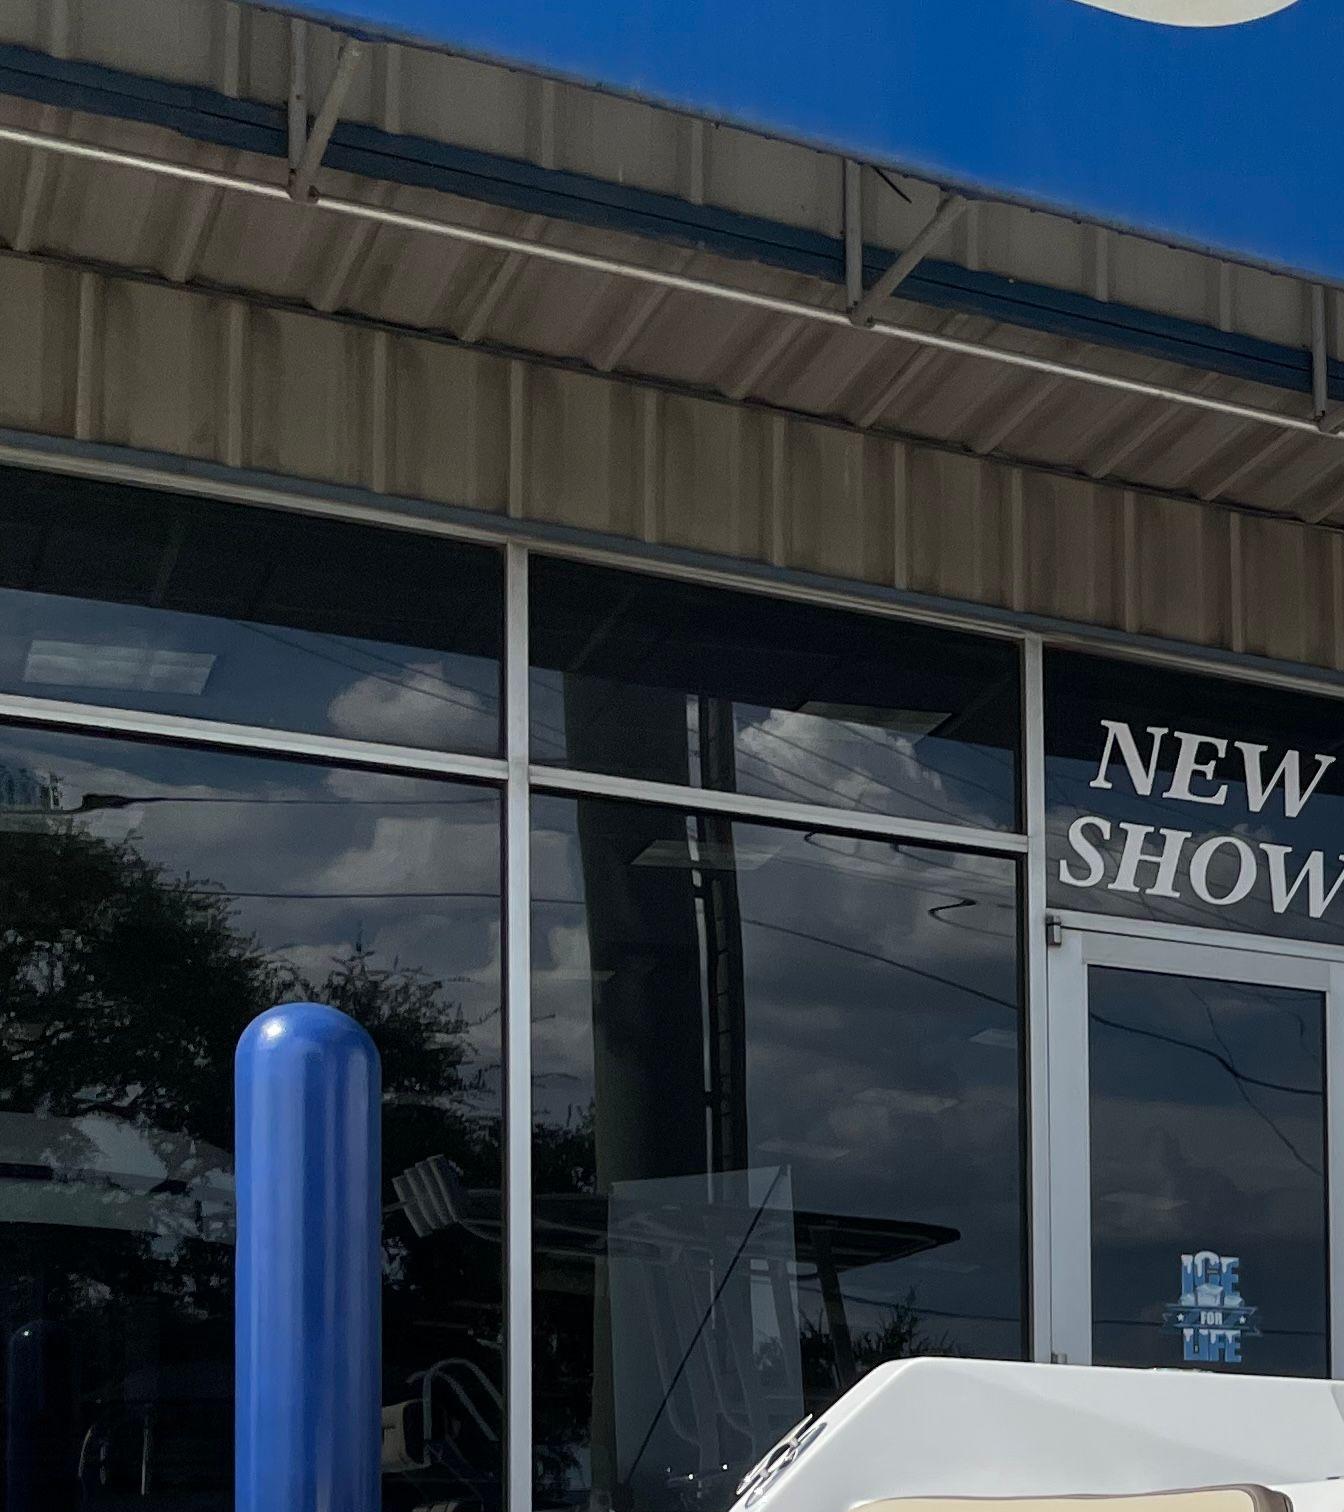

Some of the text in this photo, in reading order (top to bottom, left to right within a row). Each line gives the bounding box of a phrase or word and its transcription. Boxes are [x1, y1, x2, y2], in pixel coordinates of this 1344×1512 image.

[1089, 719, 1336, 818] NEW
[1180, 1250, 1243, 1306] ICE
[1200, 1311, 1222, 1325] FOR
[1183, 1328, 1242, 1362] LIFE
